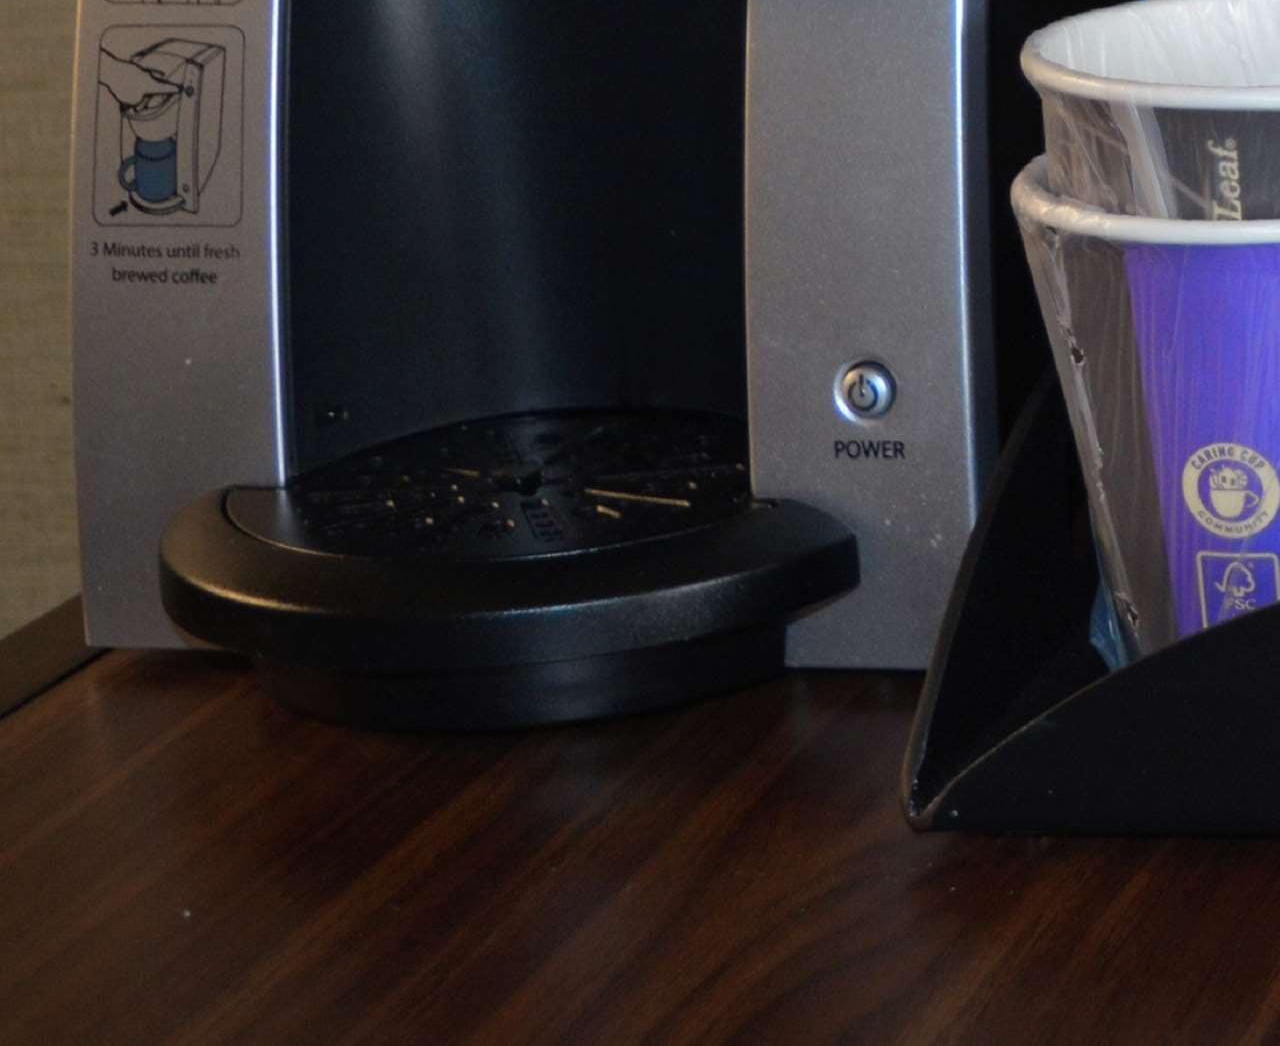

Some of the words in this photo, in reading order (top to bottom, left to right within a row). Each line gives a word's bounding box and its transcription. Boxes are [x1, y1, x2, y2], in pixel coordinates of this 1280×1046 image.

[1207, 139, 1243, 220] Leaf
[90, 243, 99, 255] 3
[102, 243, 162, 258] Minutes
[167, 243, 199, 259] until
[203, 244, 241, 260] fresh
[112, 268, 168, 283] brewed
[171, 269, 217, 284] coffee
[834, 441, 905, 459] POWER
[1191, 446, 1235, 471] CARING
[1240, 449, 1265, 470] CUP
[1197, 510, 1269, 535] COMMUNITY
[1226, 598, 1257, 611] FSC
